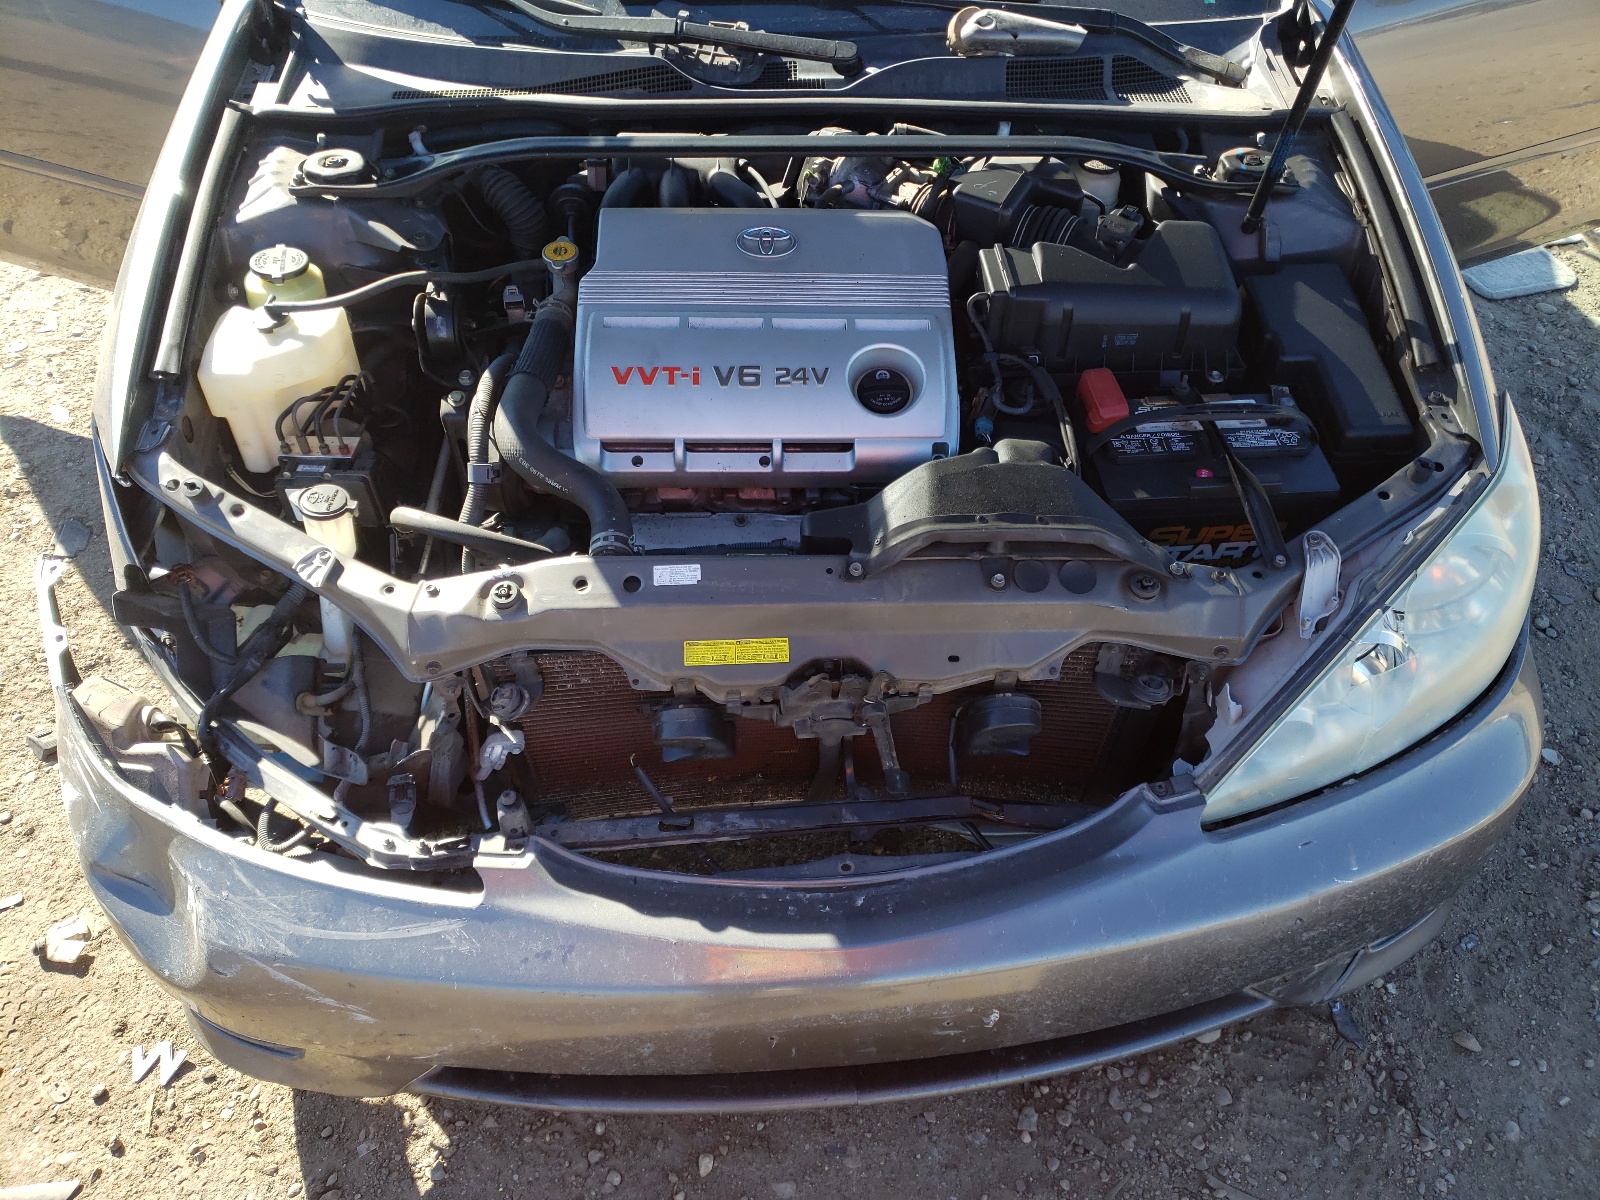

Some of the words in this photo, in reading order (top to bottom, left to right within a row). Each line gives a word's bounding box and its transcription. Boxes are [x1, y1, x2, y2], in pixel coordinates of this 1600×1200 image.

[610, 366, 701, 387] VVT-i
[712, 365, 762, 388] V6
[775, 367, 830, 388] 24V
[1151, 522, 1288, 545] SUPE
[1164, 541, 1263, 562] TART
